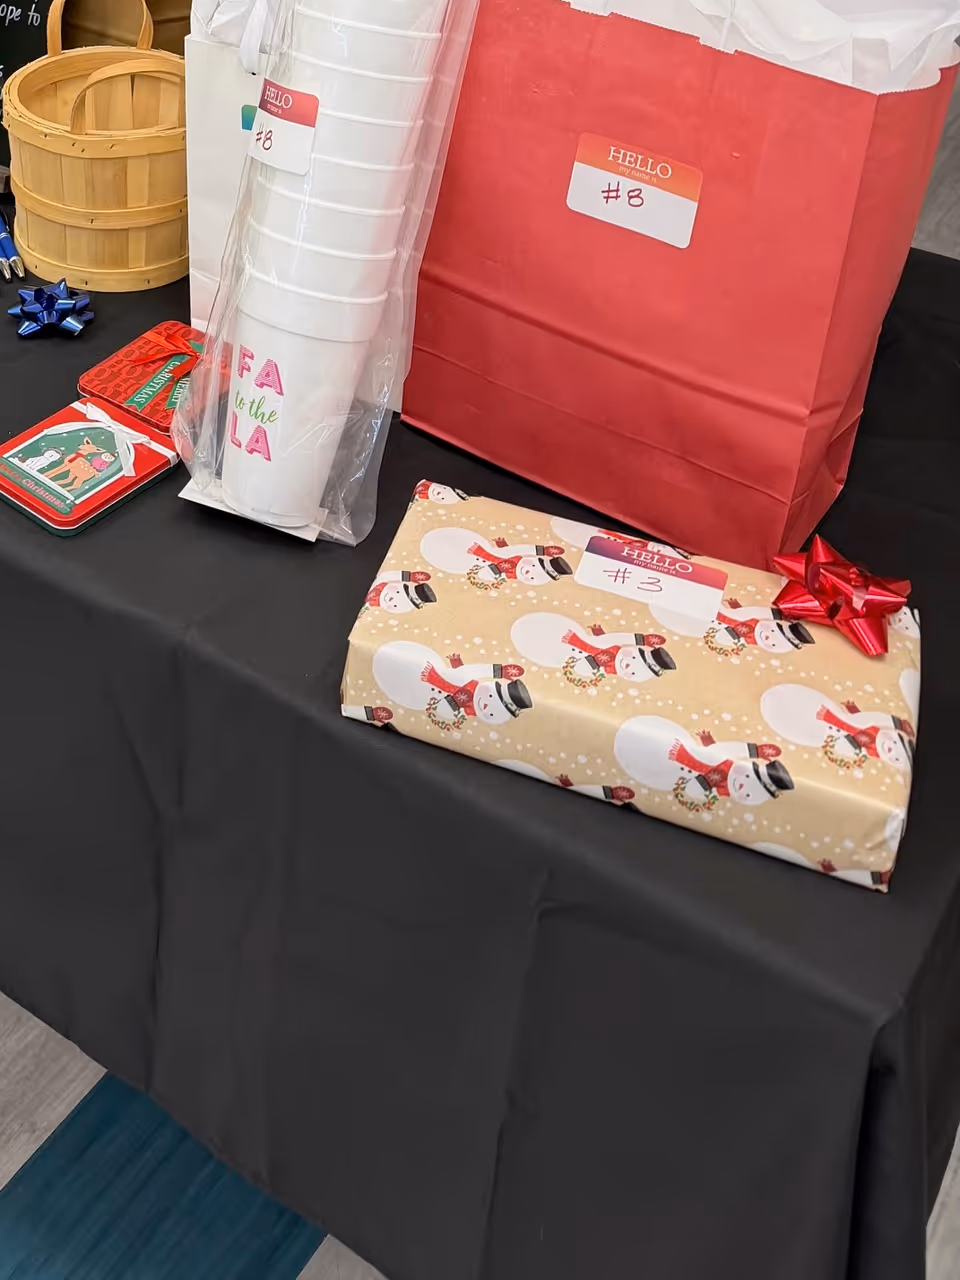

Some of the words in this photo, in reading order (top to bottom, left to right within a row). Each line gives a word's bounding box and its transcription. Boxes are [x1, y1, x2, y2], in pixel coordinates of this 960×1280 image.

[27, 4, 41, 27] to
[264, 85, 292, 109] HELLO
[255, 120, 273, 151] #8
[608, 146, 672, 179] HELLO
[631, 169, 651, 181] name
[601, 181, 645, 208] #8
[237, 344, 284, 396] FA
[234, 390, 248, 410] to
[248, 396, 280, 424] the
[230, 409, 272, 462] LA
[22, 478, 66, 509] Christmas
[620, 546, 694, 574] HELLO
[633, 559, 648, 567] my
[647, 562, 669, 573] name
